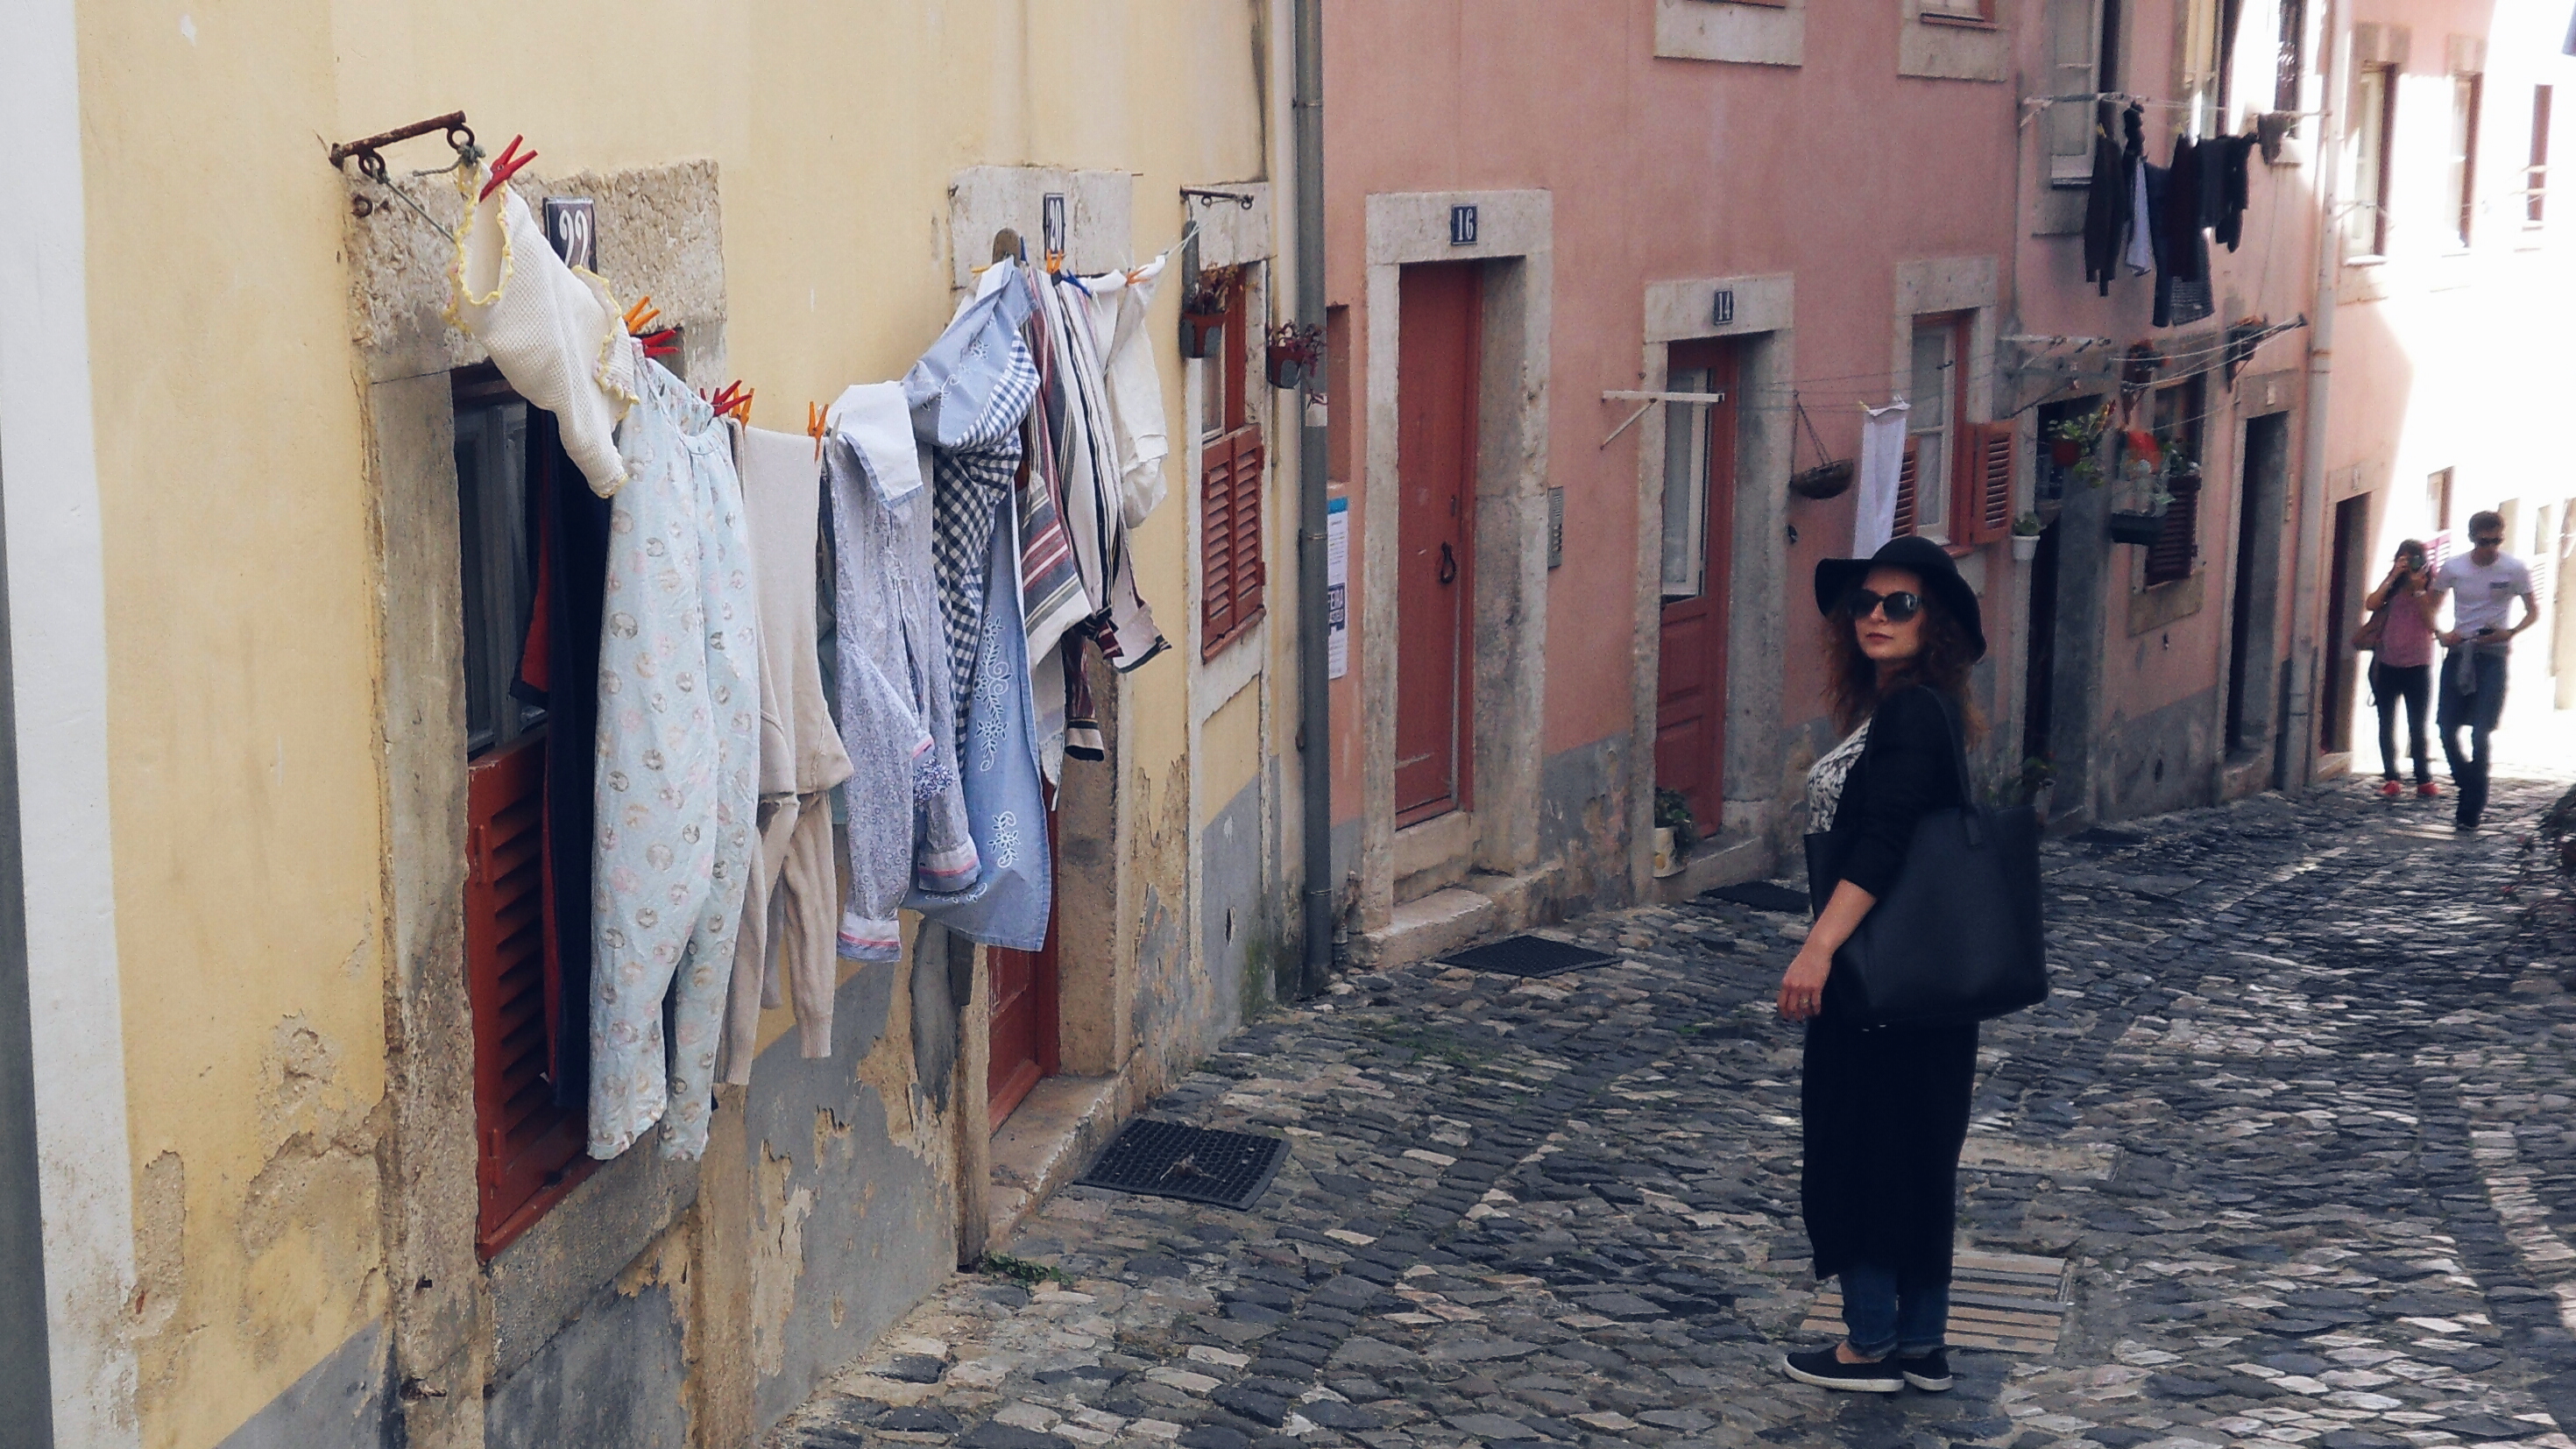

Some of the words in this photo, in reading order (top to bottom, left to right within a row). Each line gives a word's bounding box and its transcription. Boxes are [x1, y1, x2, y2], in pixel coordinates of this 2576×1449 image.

[1049, 199, 1063, 251] 20
[1458, 209, 1474, 241] 16
[1718, 291, 1730, 321] 14
